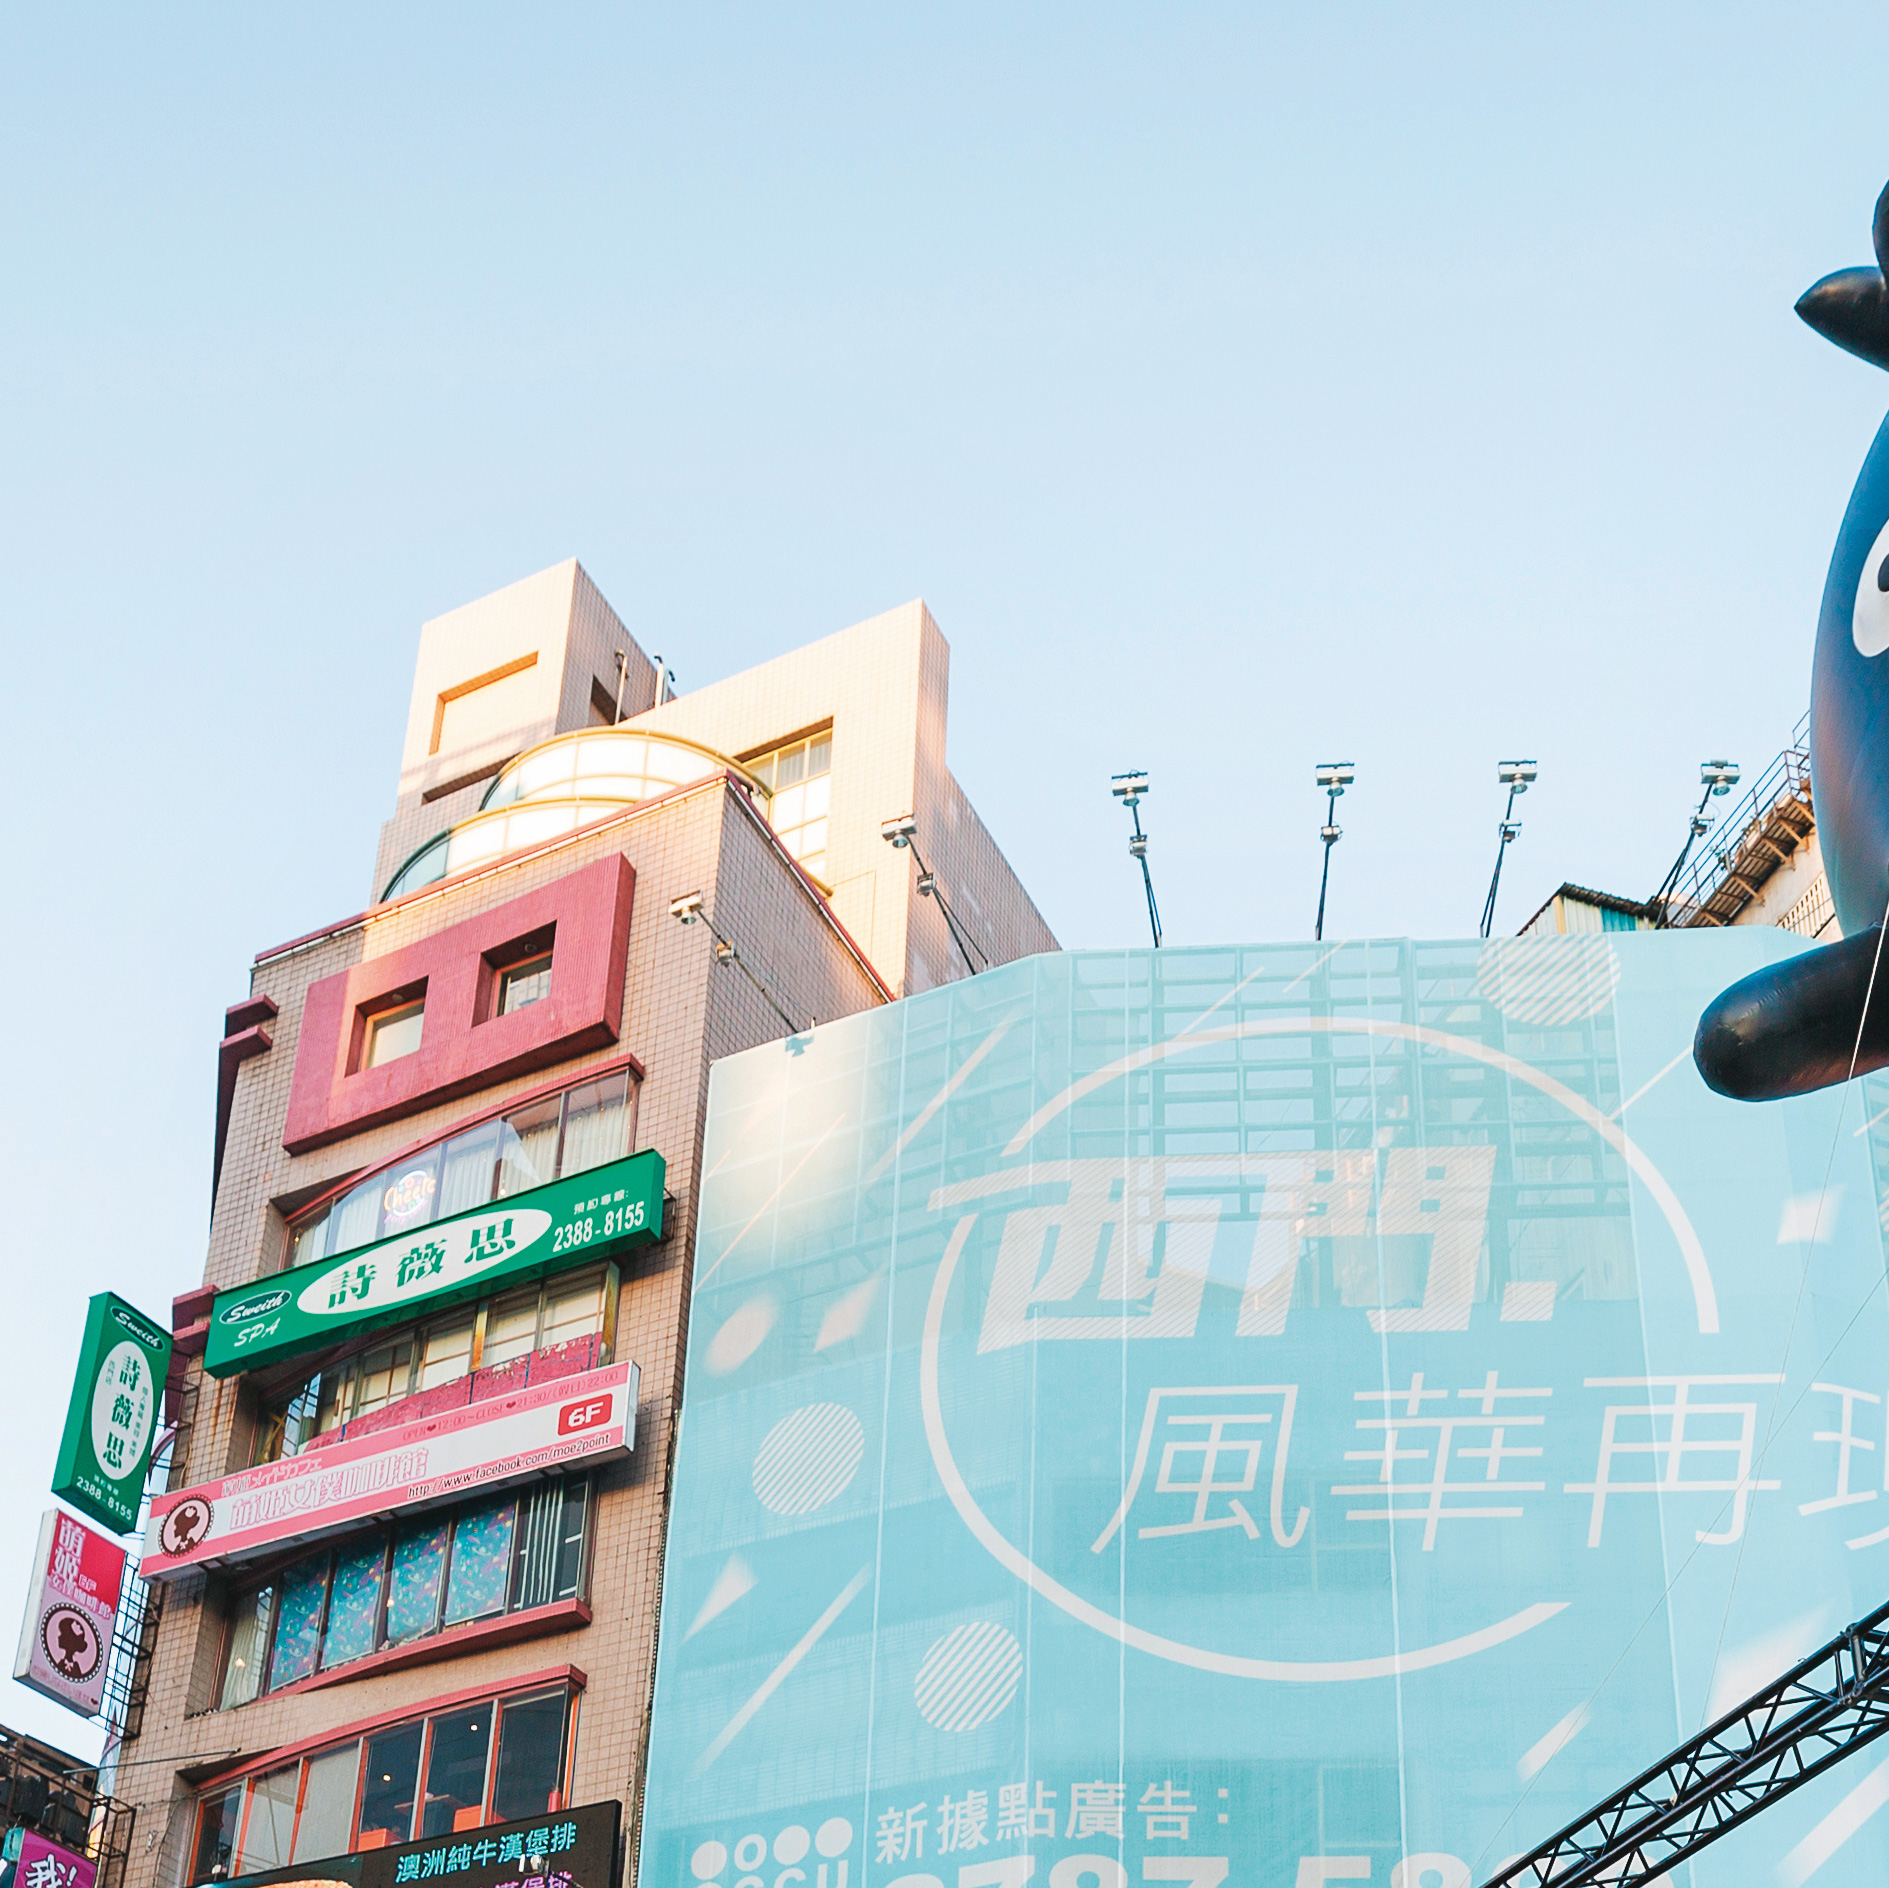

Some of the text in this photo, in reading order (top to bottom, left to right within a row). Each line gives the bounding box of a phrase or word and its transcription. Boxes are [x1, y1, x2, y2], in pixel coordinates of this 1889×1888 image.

[553, 1201, 645, 1253] 2388-8155
[234, 1317, 280, 1347] SPA
[567, 1402, 604, 1428] 6F
[76, 1474, 133, 1522] 2388-8155
